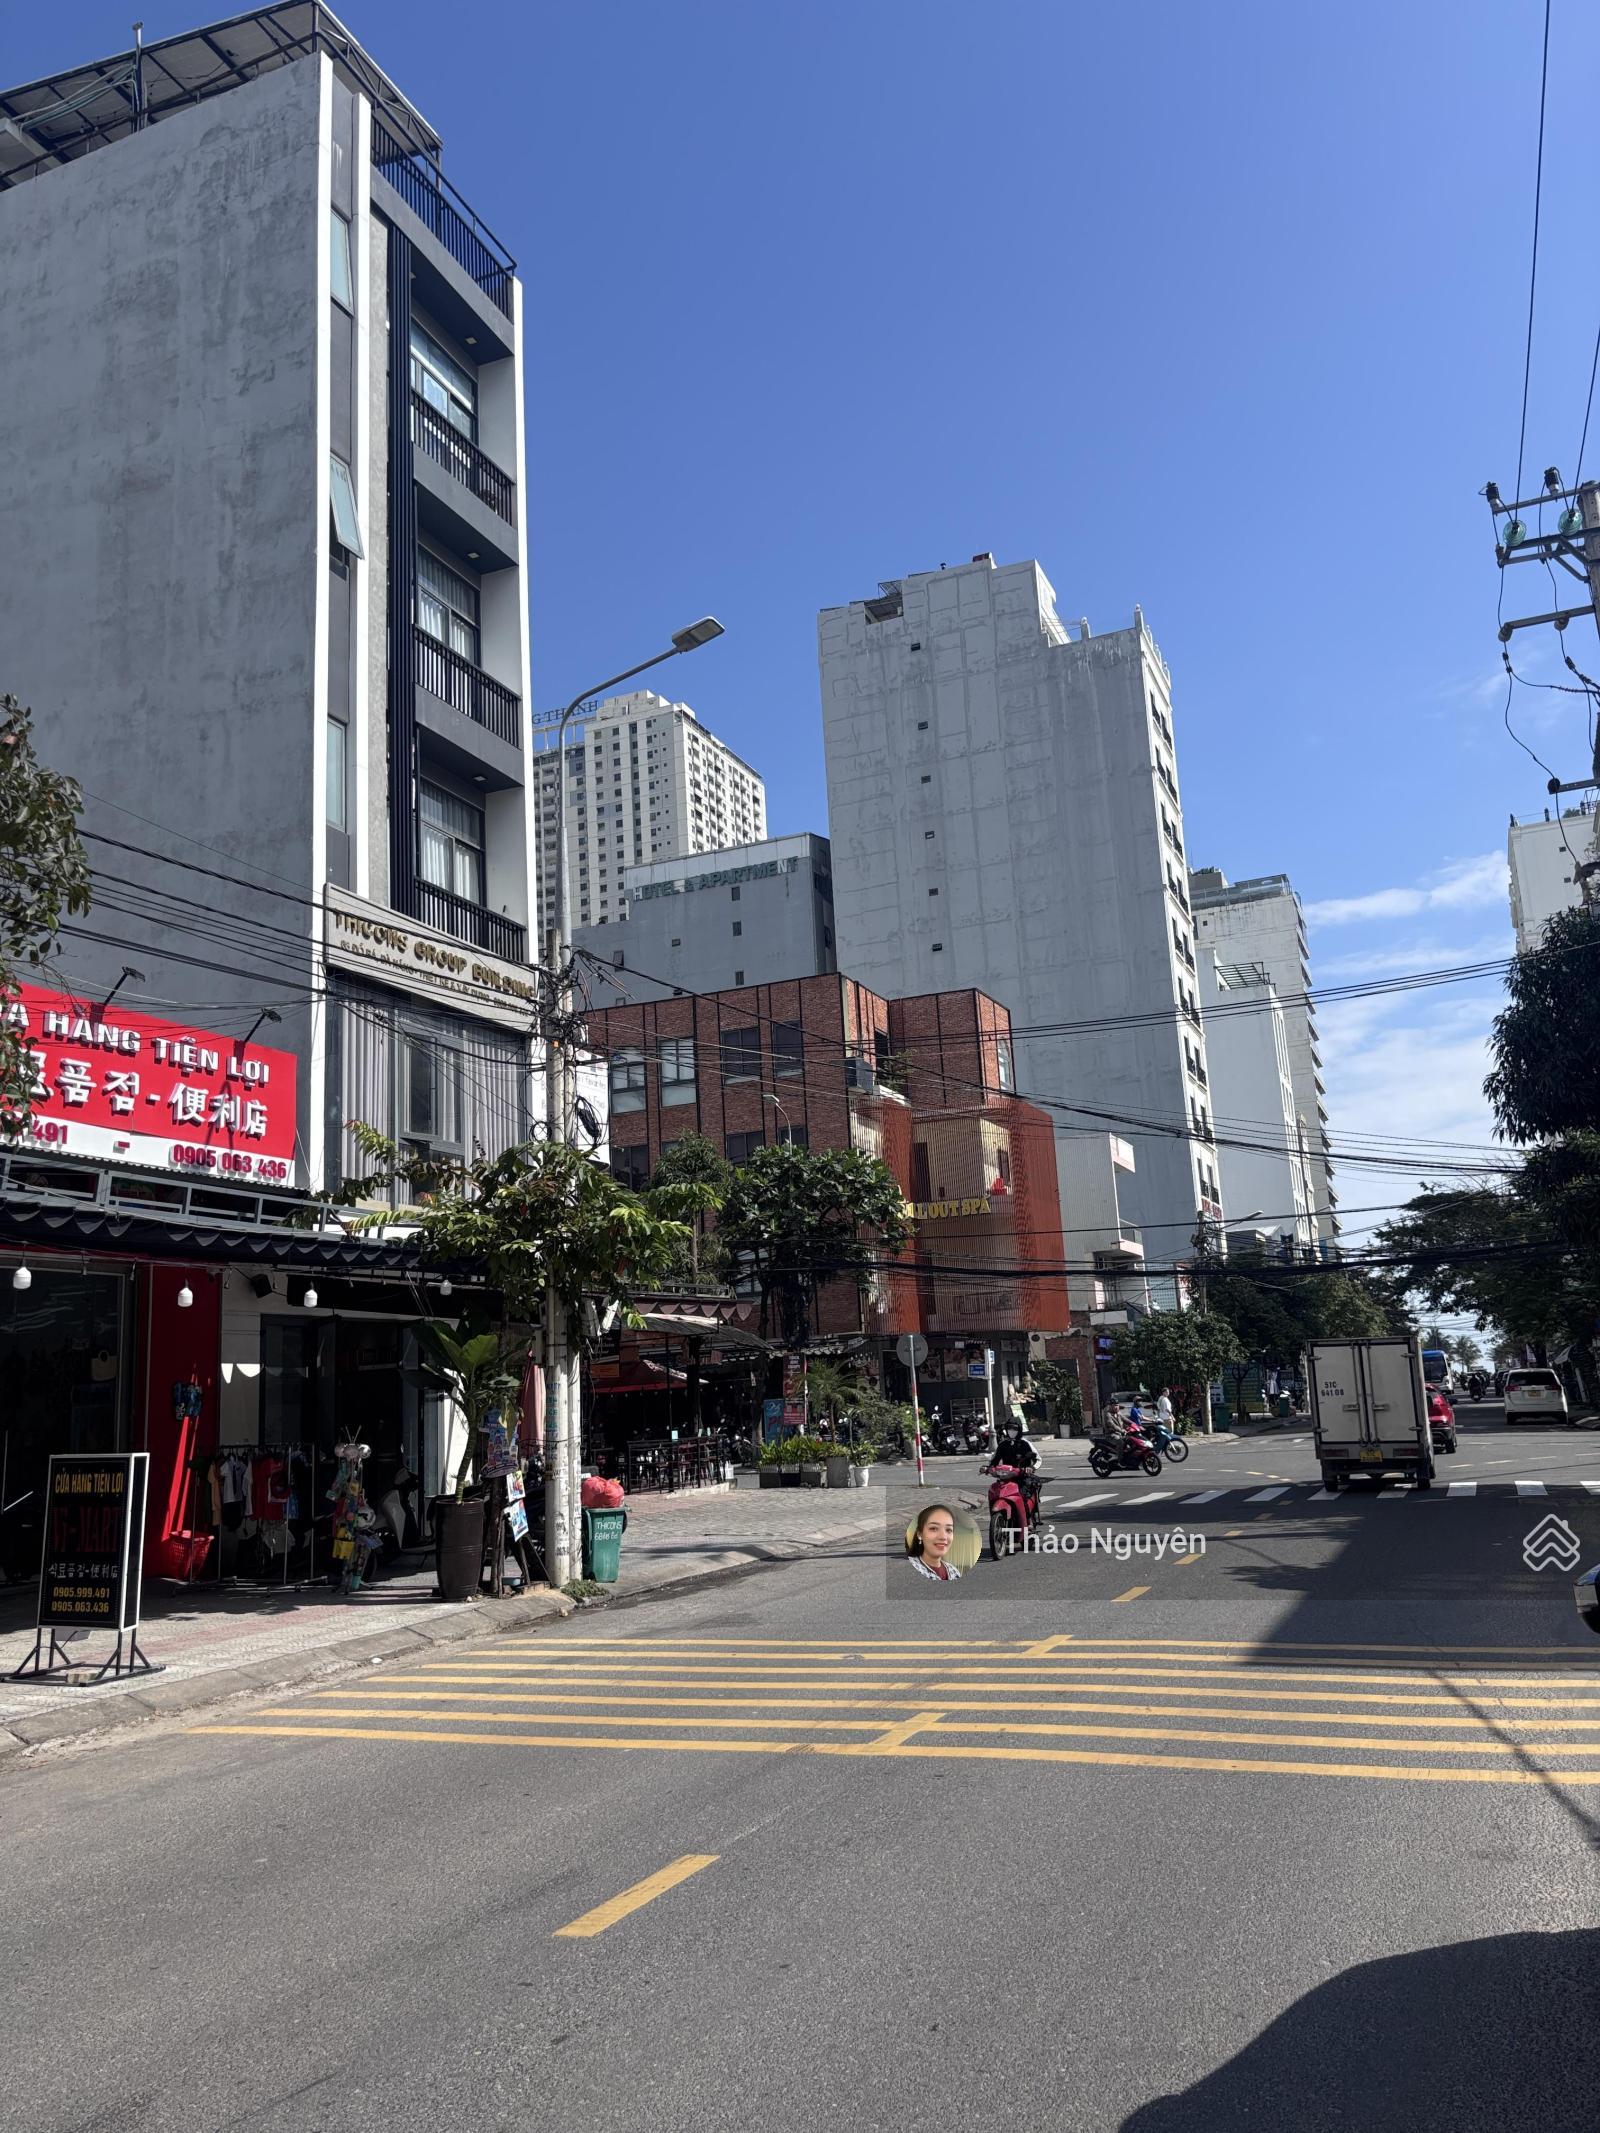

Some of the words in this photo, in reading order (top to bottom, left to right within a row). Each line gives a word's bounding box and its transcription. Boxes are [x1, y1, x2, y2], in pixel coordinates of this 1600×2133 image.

[633, 879, 685, 901] HOTEL
[698, 856, 799, 890] APARTMENT
[413, 940, 468, 975] GROUP
[471, 962, 538, 1000] BUILDING
[153, 1034, 220, 1075] TIỆN
[227, 1055, 270, 1088] LỢI
[172, 1144, 217, 1168] 0905
[221, 1152, 252, 1174] 063
[257, 1158, 287, 1179] 436
[961, 1198, 991, 1216] SPA
[1324, 1381, 1337, 1389] 51C
[53, 1586, 110, 1599] 0905.999.491
[51, 1601, 110, 1614] 0905.063.436
